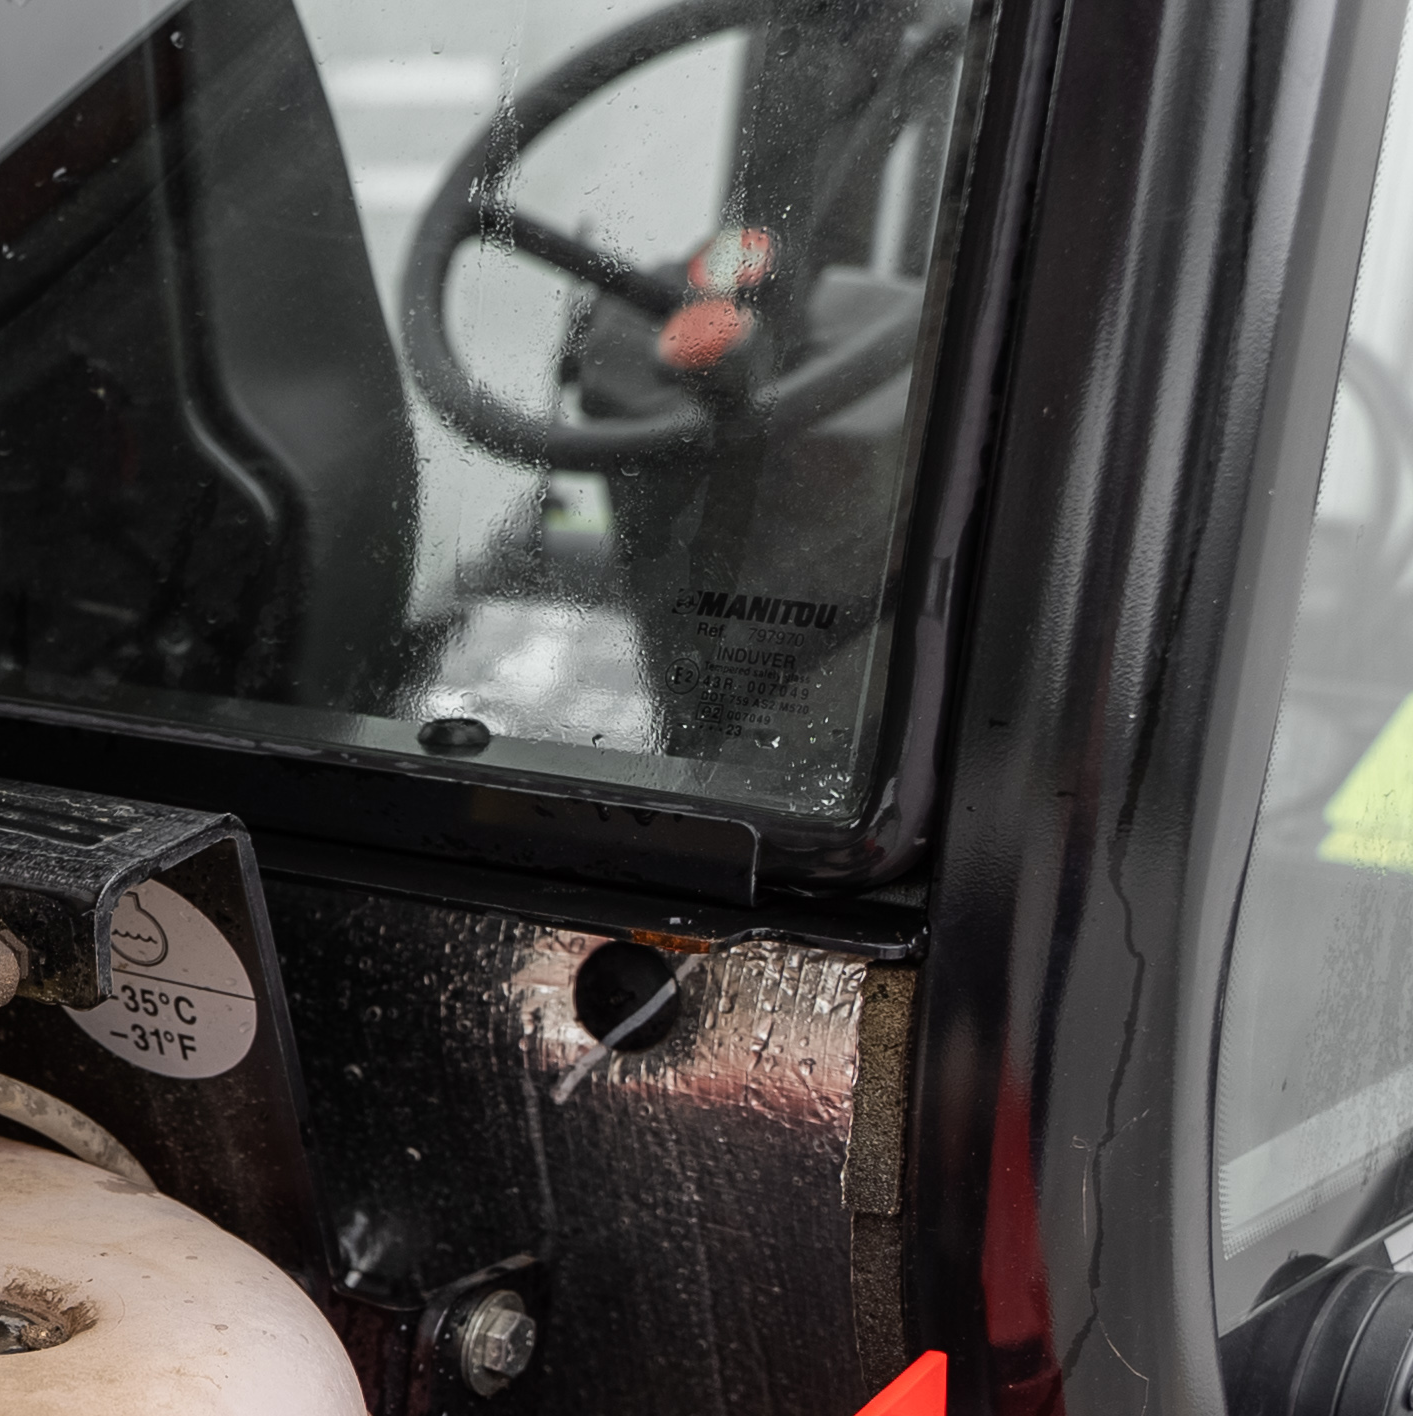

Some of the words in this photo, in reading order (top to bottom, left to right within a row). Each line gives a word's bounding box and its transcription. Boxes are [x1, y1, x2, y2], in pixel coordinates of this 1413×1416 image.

[697, 591, 838, 629] MANITOU
[749, 628, 805, 647] 797970
[717, 647, 797, 669] INDUVER
[701, 691, 726, 702] DOT
[109, 1024, 197, 1061] -31°F
